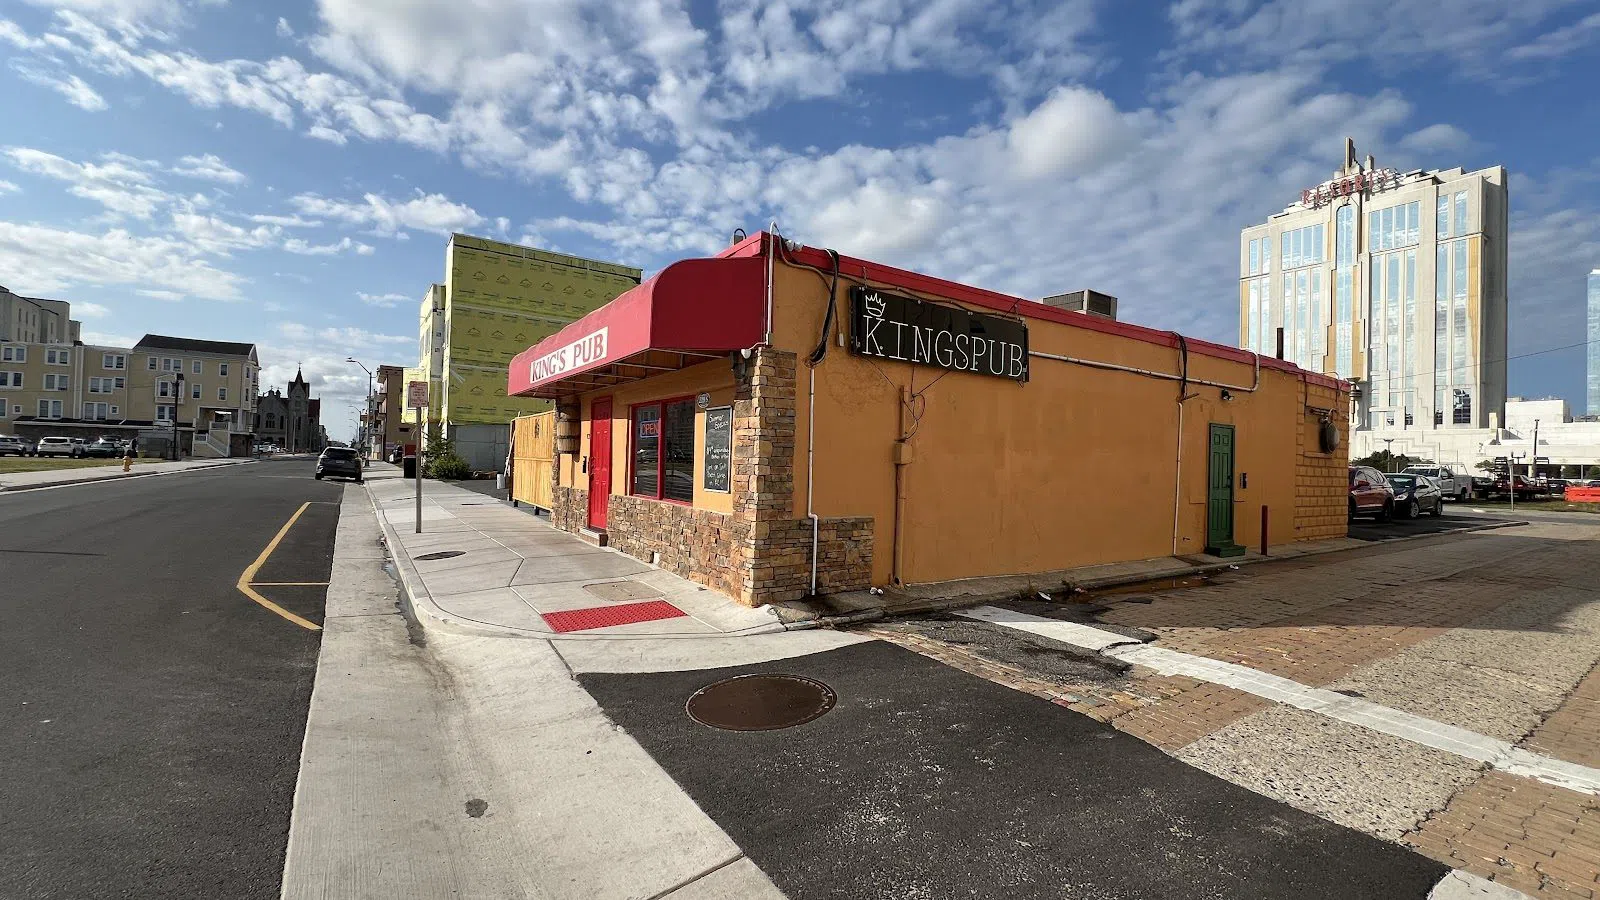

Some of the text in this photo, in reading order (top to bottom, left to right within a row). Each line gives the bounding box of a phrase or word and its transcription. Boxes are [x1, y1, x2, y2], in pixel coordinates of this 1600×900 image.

[532, 333, 604, 381] KING'S PUB
[642, 423, 660, 436] OPEN
